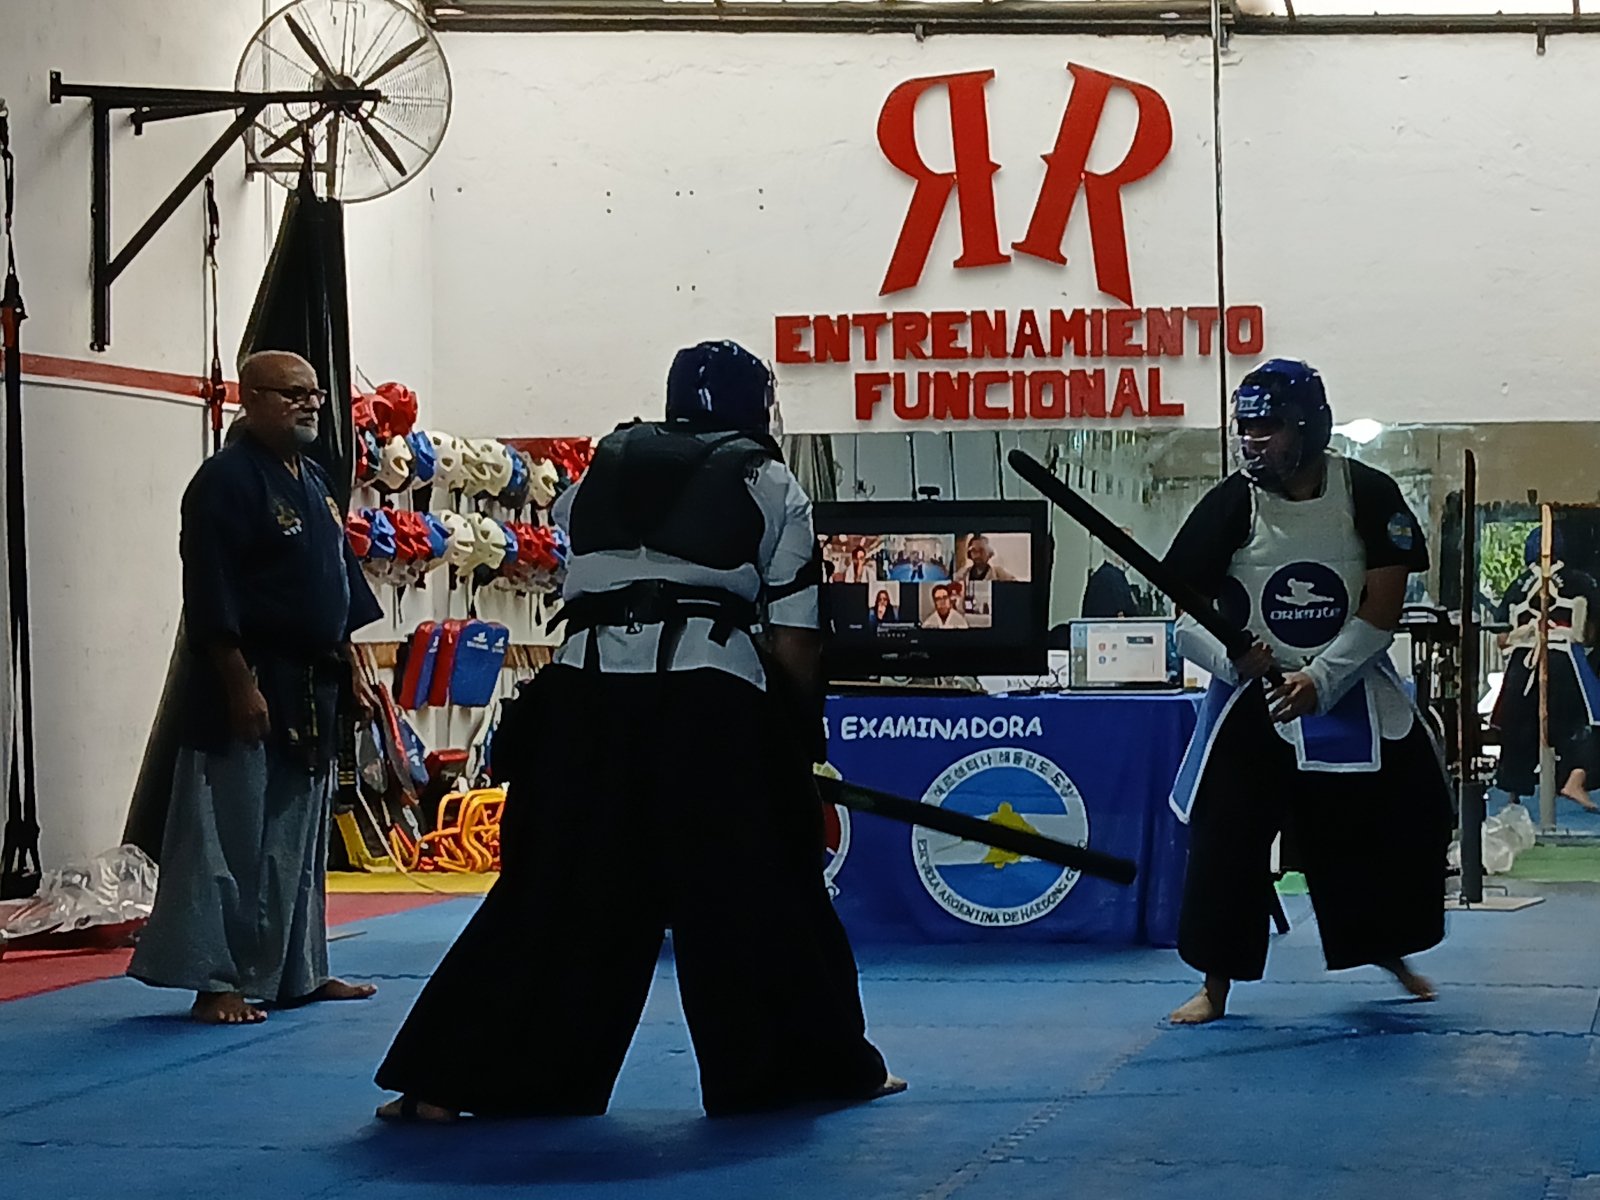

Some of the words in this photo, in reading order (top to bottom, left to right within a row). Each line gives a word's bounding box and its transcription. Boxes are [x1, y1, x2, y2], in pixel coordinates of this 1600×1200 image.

[775, 305, 1265, 364] ENTRENAMIENTO
[854, 367, 1185, 421] FUNCIONAL
[841, 715, 1043, 740] EXAMINADORA
